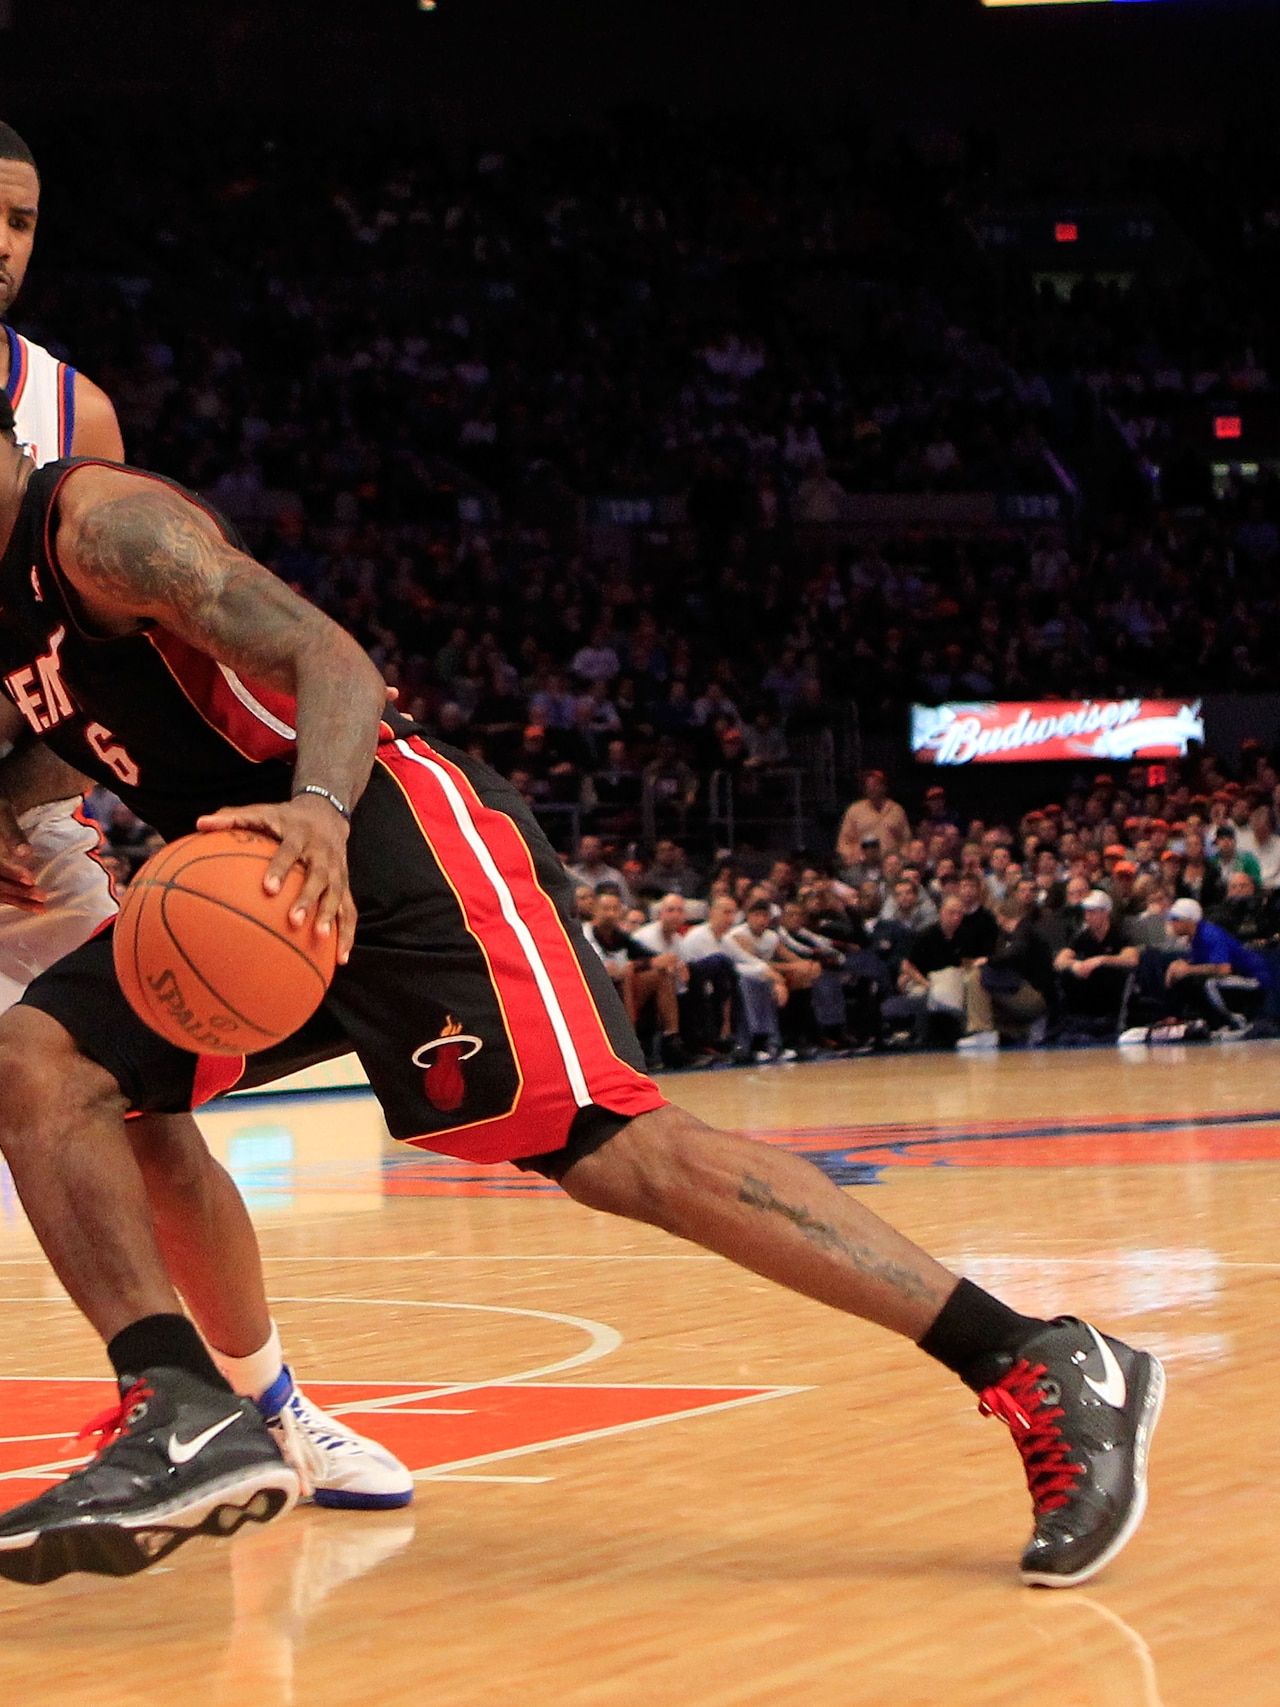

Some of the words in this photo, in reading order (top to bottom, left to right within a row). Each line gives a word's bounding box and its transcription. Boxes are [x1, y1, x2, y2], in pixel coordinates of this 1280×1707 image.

[2, 624, 75, 735] EAT
[83, 720, 141, 788] 6
[932, 698, 1141, 766] Budweiser
